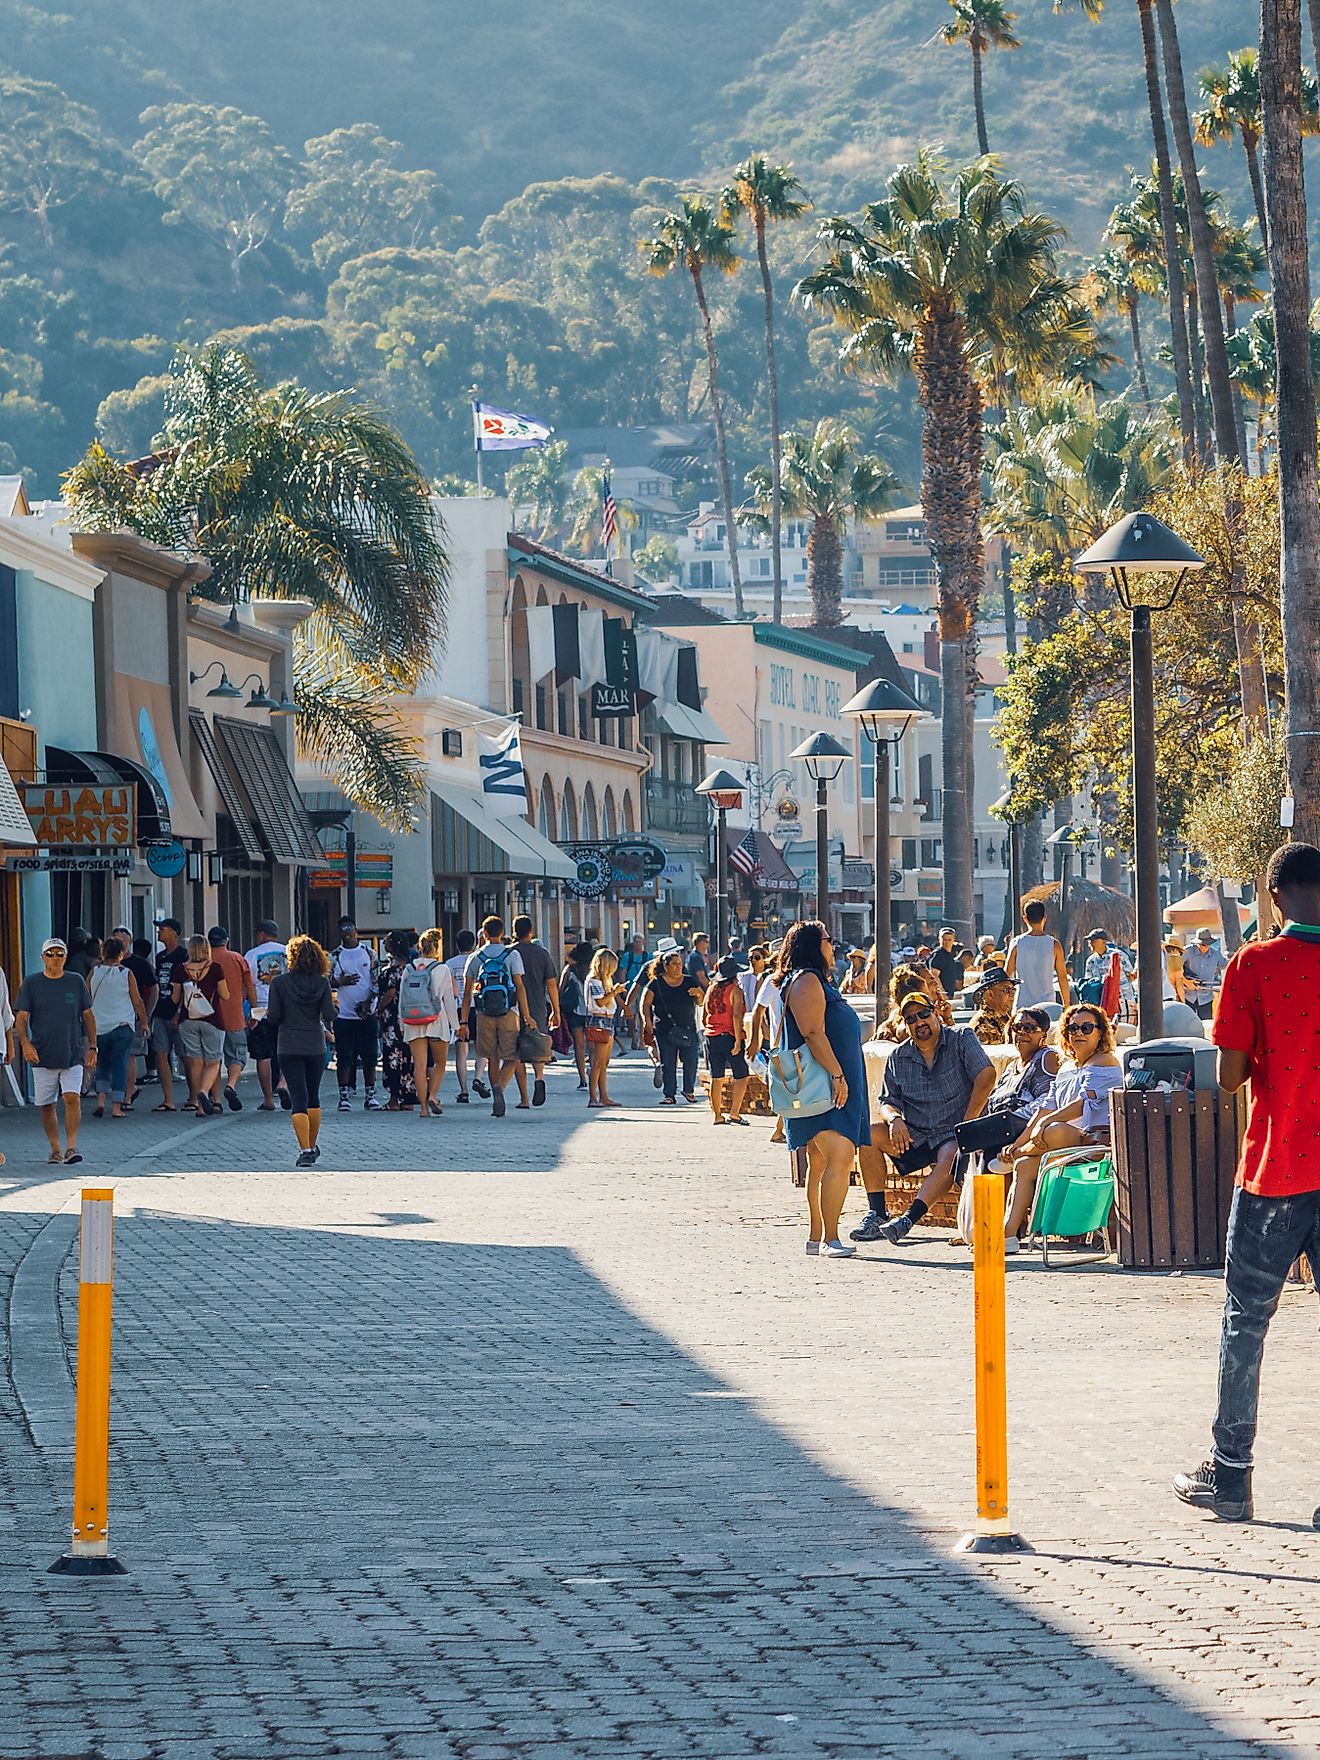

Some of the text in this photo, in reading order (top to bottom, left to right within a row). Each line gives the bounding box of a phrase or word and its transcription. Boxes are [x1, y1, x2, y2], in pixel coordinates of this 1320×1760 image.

[597, 689, 630, 704] MAR
[36, 815, 130, 844] ARRY'S
[149, 850, 186, 863] Scoops
[13, 859, 41, 870] FOOD
[565, 879, 587, 896] BREW
[588, 876, 611, 896] HOUSE
